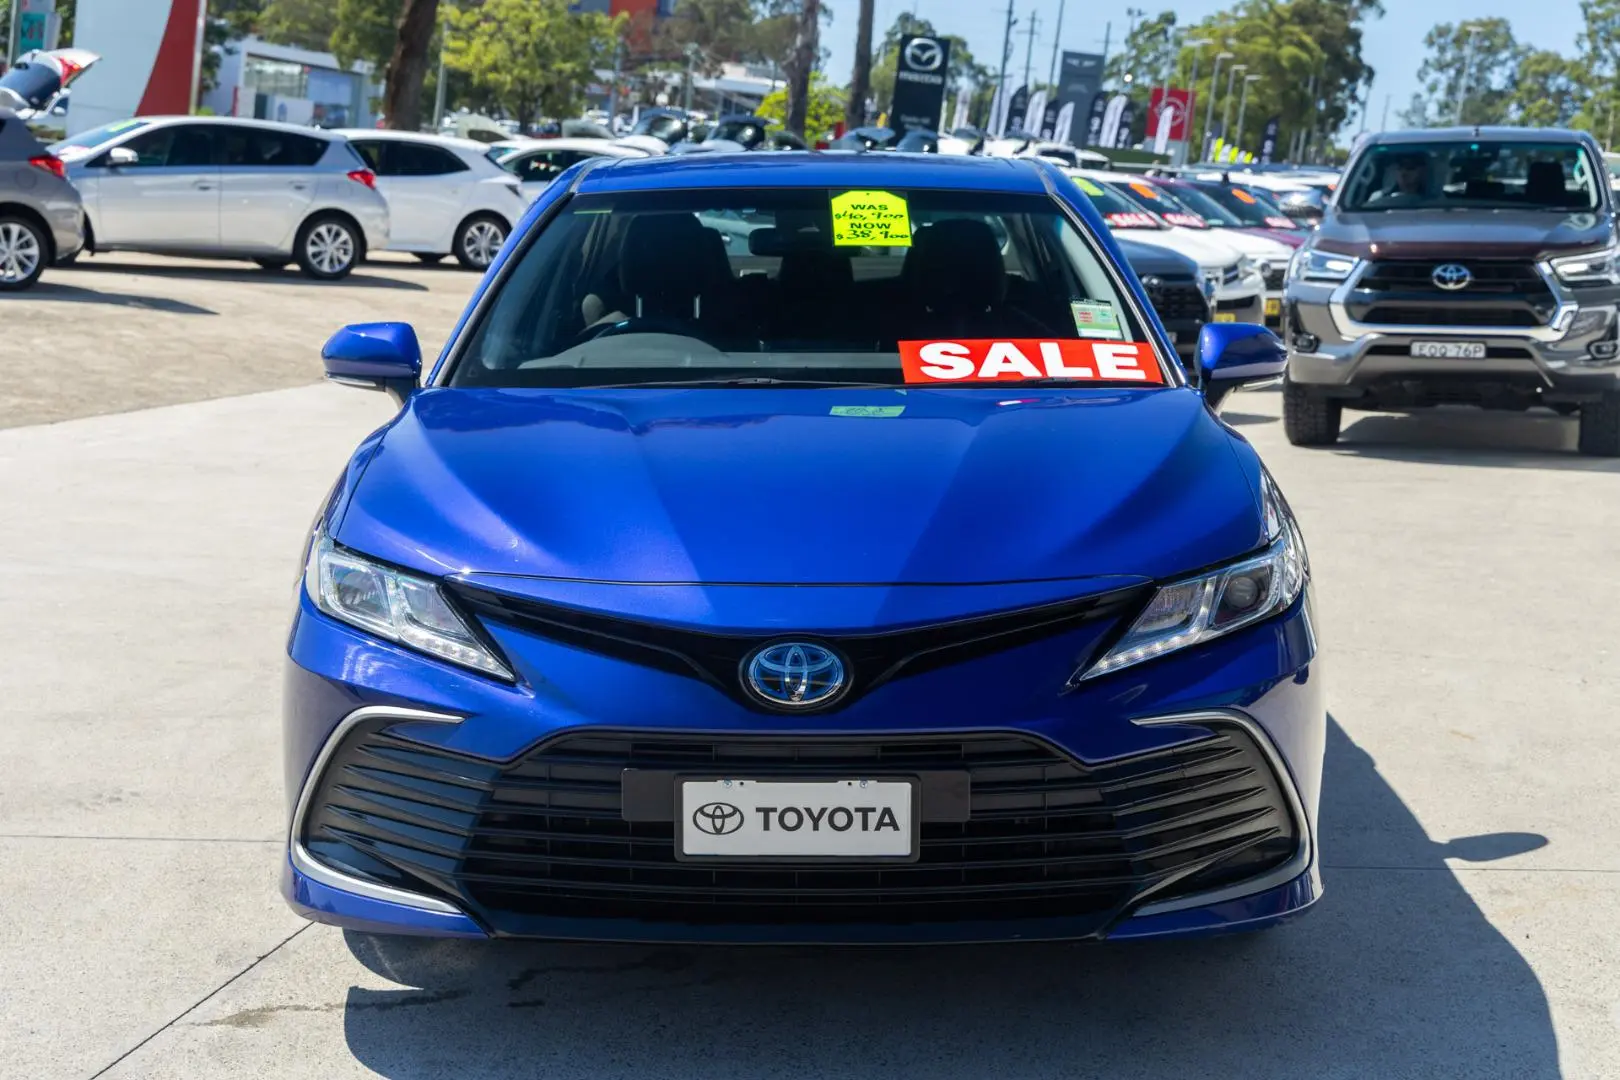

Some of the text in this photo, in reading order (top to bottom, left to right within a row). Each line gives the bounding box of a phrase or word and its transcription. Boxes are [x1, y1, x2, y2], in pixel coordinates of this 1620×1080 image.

[836, 230, 909, 240] $38,900
[919, 342, 1147, 380] SALE
[755, 806, 900, 832] TOYOTA
